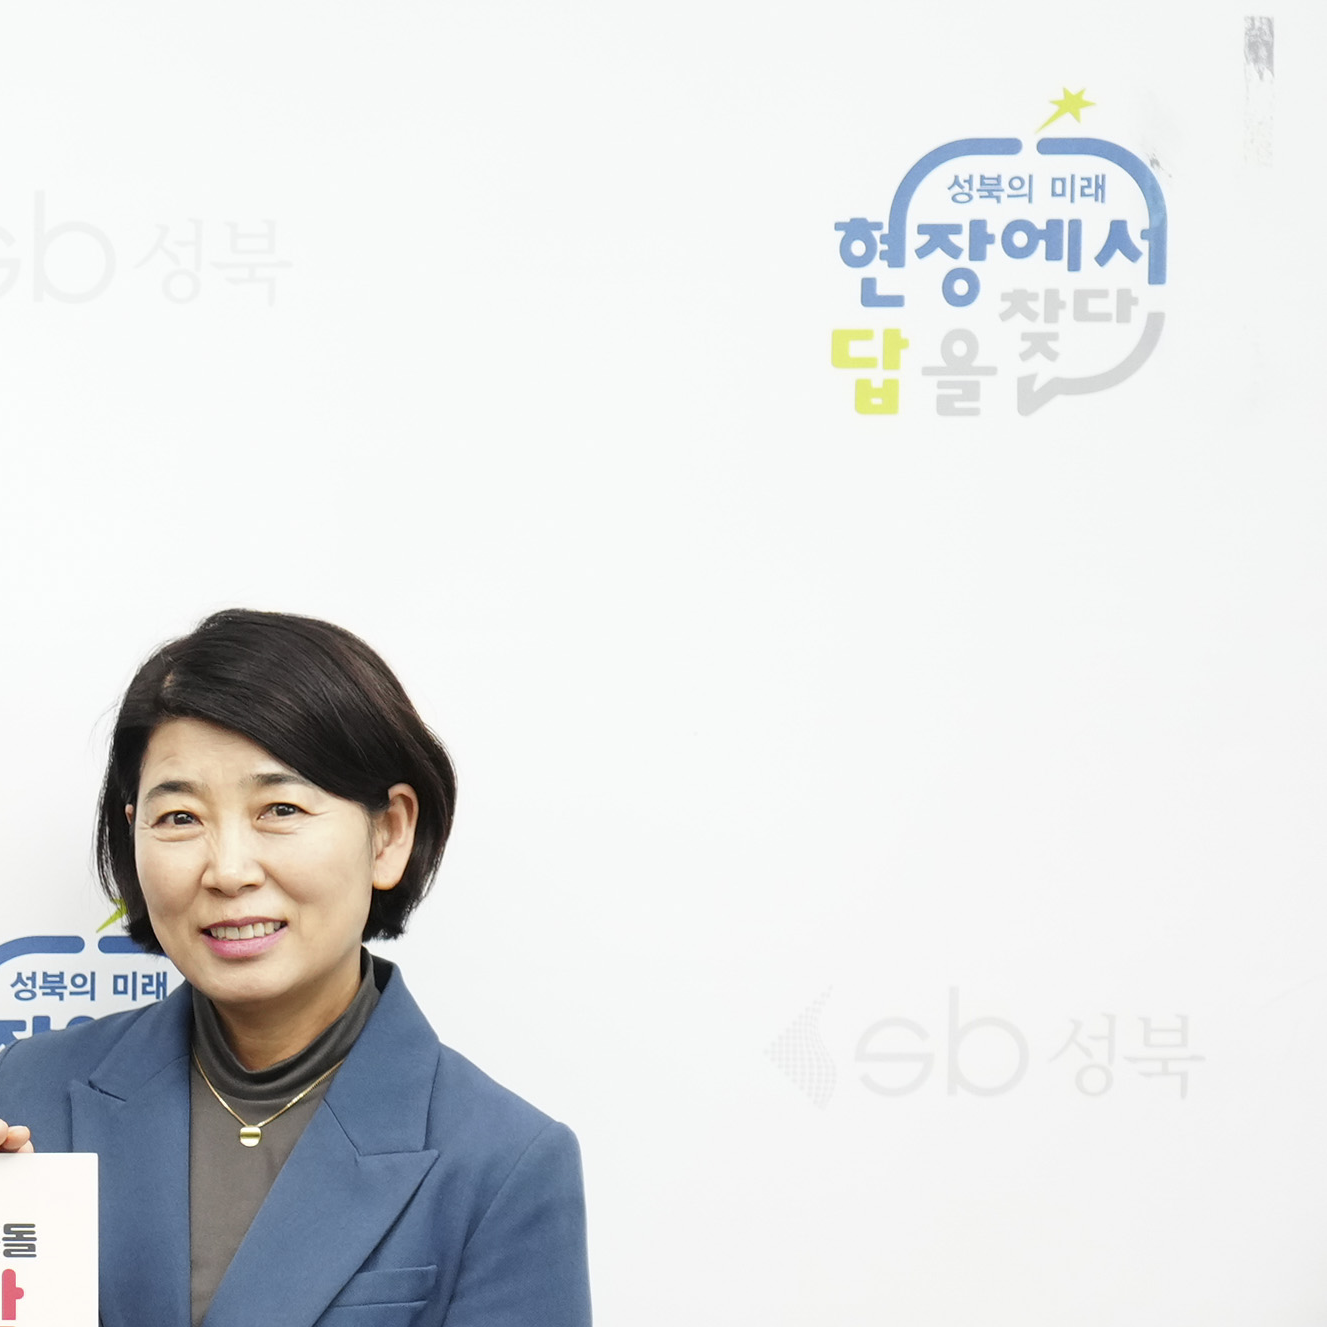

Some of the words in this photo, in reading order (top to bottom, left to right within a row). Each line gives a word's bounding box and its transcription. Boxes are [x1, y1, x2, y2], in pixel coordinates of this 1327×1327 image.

[947, 174, 1034, 204] 성북의
[1051, 174, 1107, 204] 미래
[133, 216, 294, 308] 성북
[834, 217, 1168, 308] 현장에서
[10, 971, 96, 1001] 성북의
[112, 971, 168, 1001] 미래
[854, 985, 1030, 1098] sb
[1048, 1011, 1207, 1100] 성북
